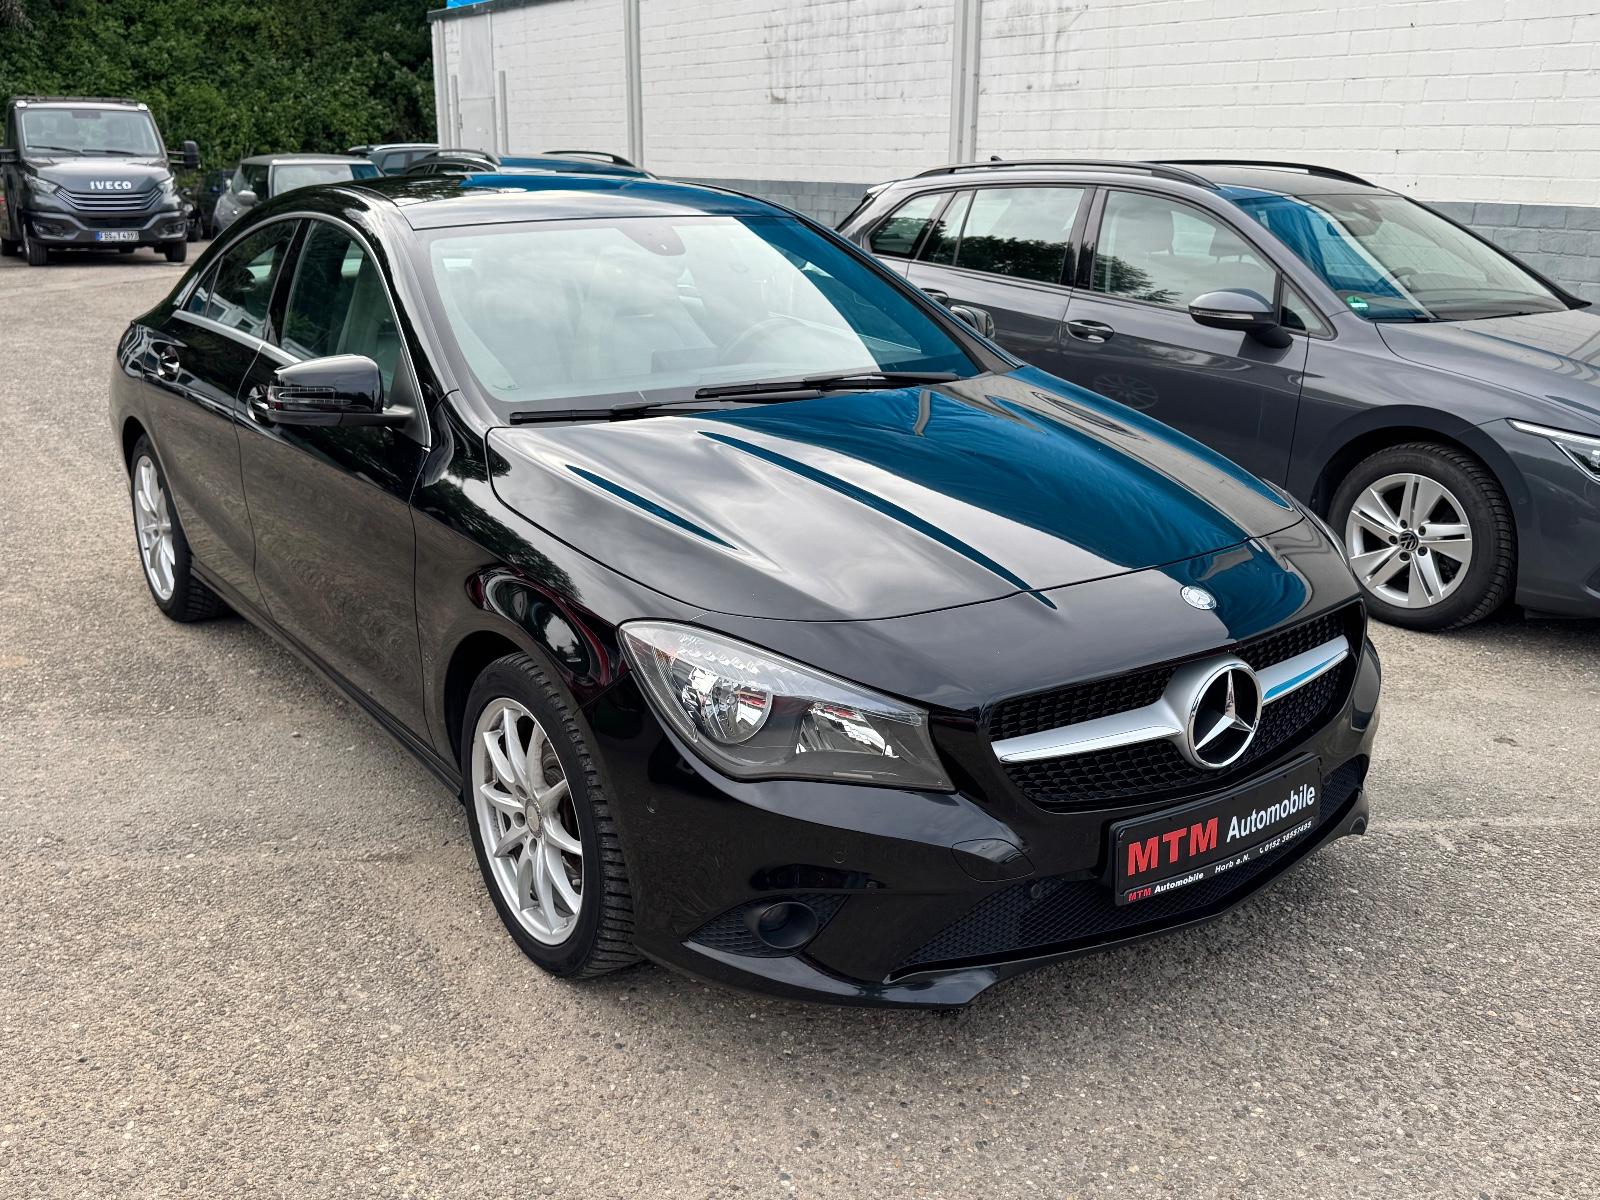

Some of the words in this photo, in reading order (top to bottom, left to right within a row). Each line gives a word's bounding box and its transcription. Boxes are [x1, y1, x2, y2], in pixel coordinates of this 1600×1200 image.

[90, 181, 132, 190] IVECO
[1128, 817, 1218, 875] MTM
[1227, 784, 1315, 842] Automobile
[1128, 888, 1151, 902] MTM
[1154, 872, 1204, 893] Automobile
[1215, 862, 1234, 873] Horb
